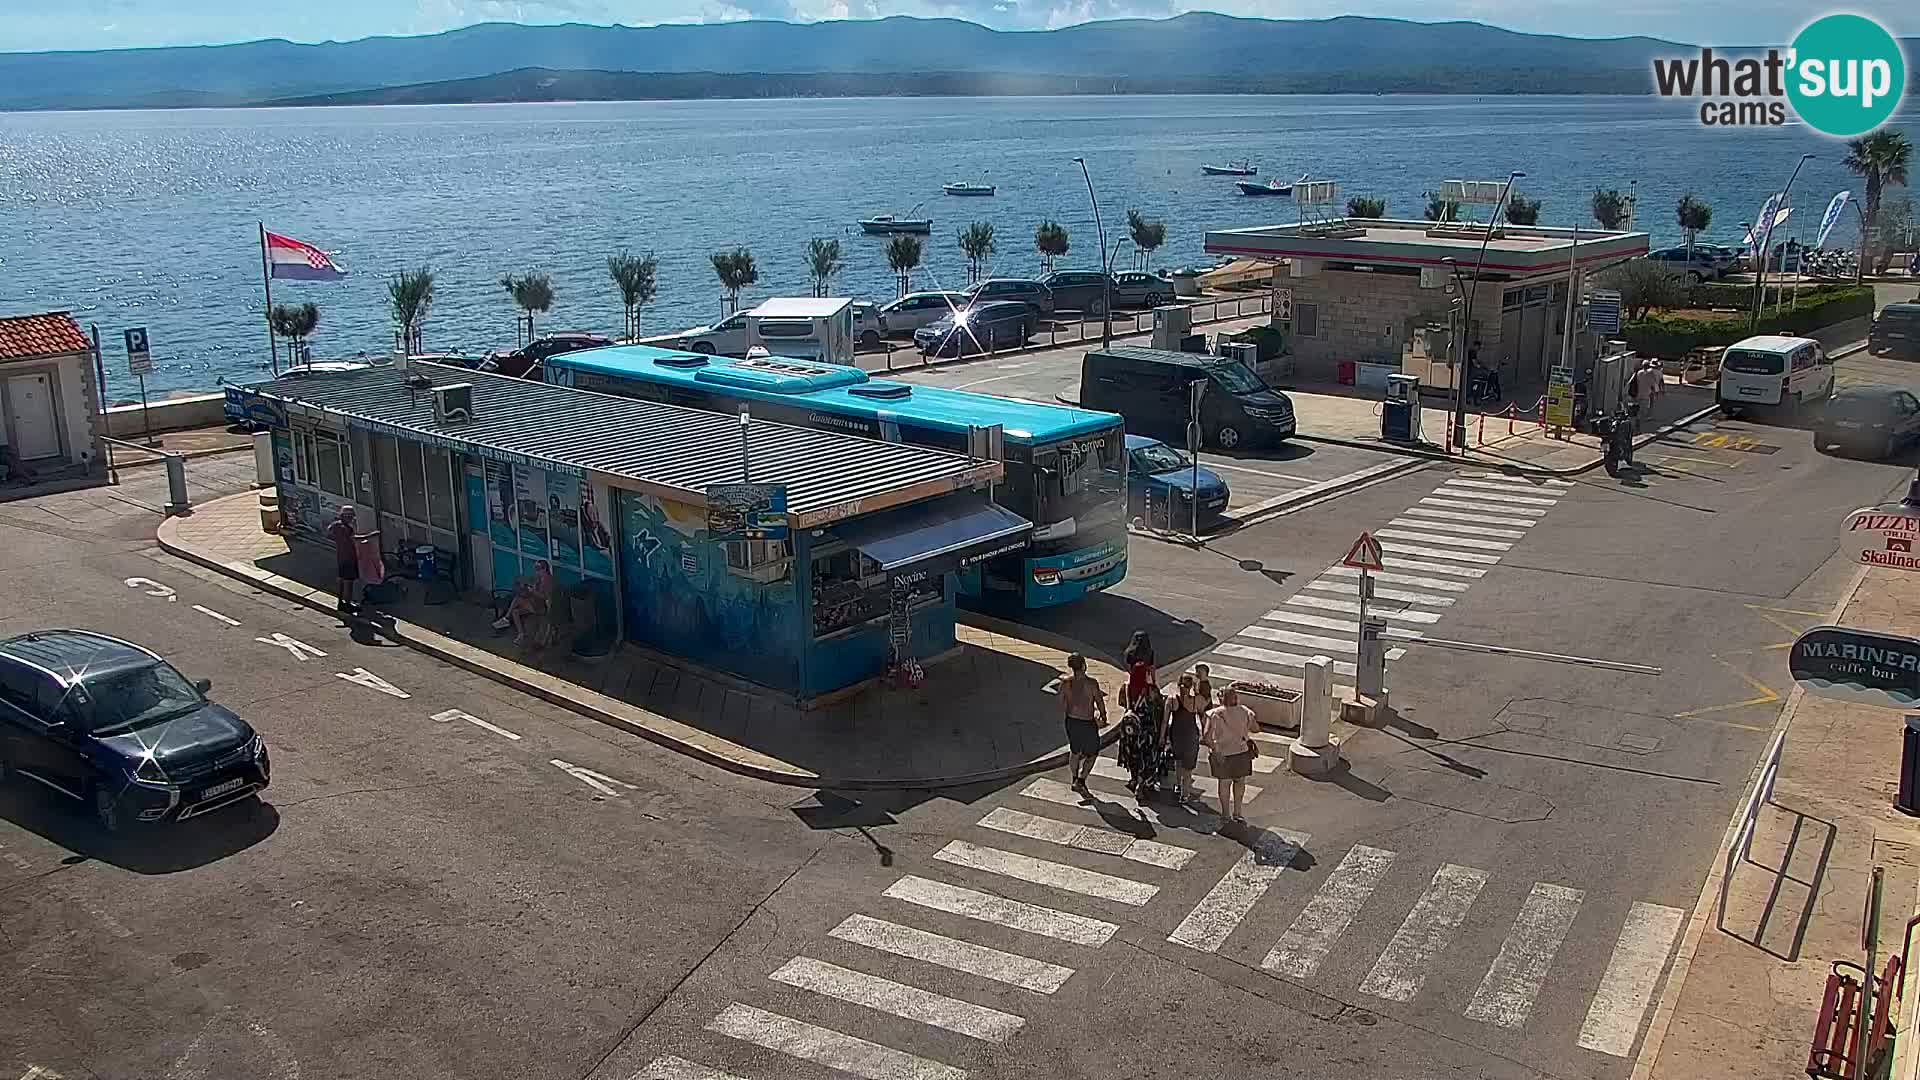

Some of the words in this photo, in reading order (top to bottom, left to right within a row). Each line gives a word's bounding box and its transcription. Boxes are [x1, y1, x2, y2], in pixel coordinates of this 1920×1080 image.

[130, 331, 142, 350] P
[494, 450, 526, 464] STATION
[529, 457, 554, 470] TICKET
[556, 464, 583, 477] OFFICE
[1848, 515, 1920, 534] PIZZE
[1802, 642, 1920, 673] MARINER
[1829, 662, 1866, 674] caffe
[1872, 665, 1898, 680] bar
